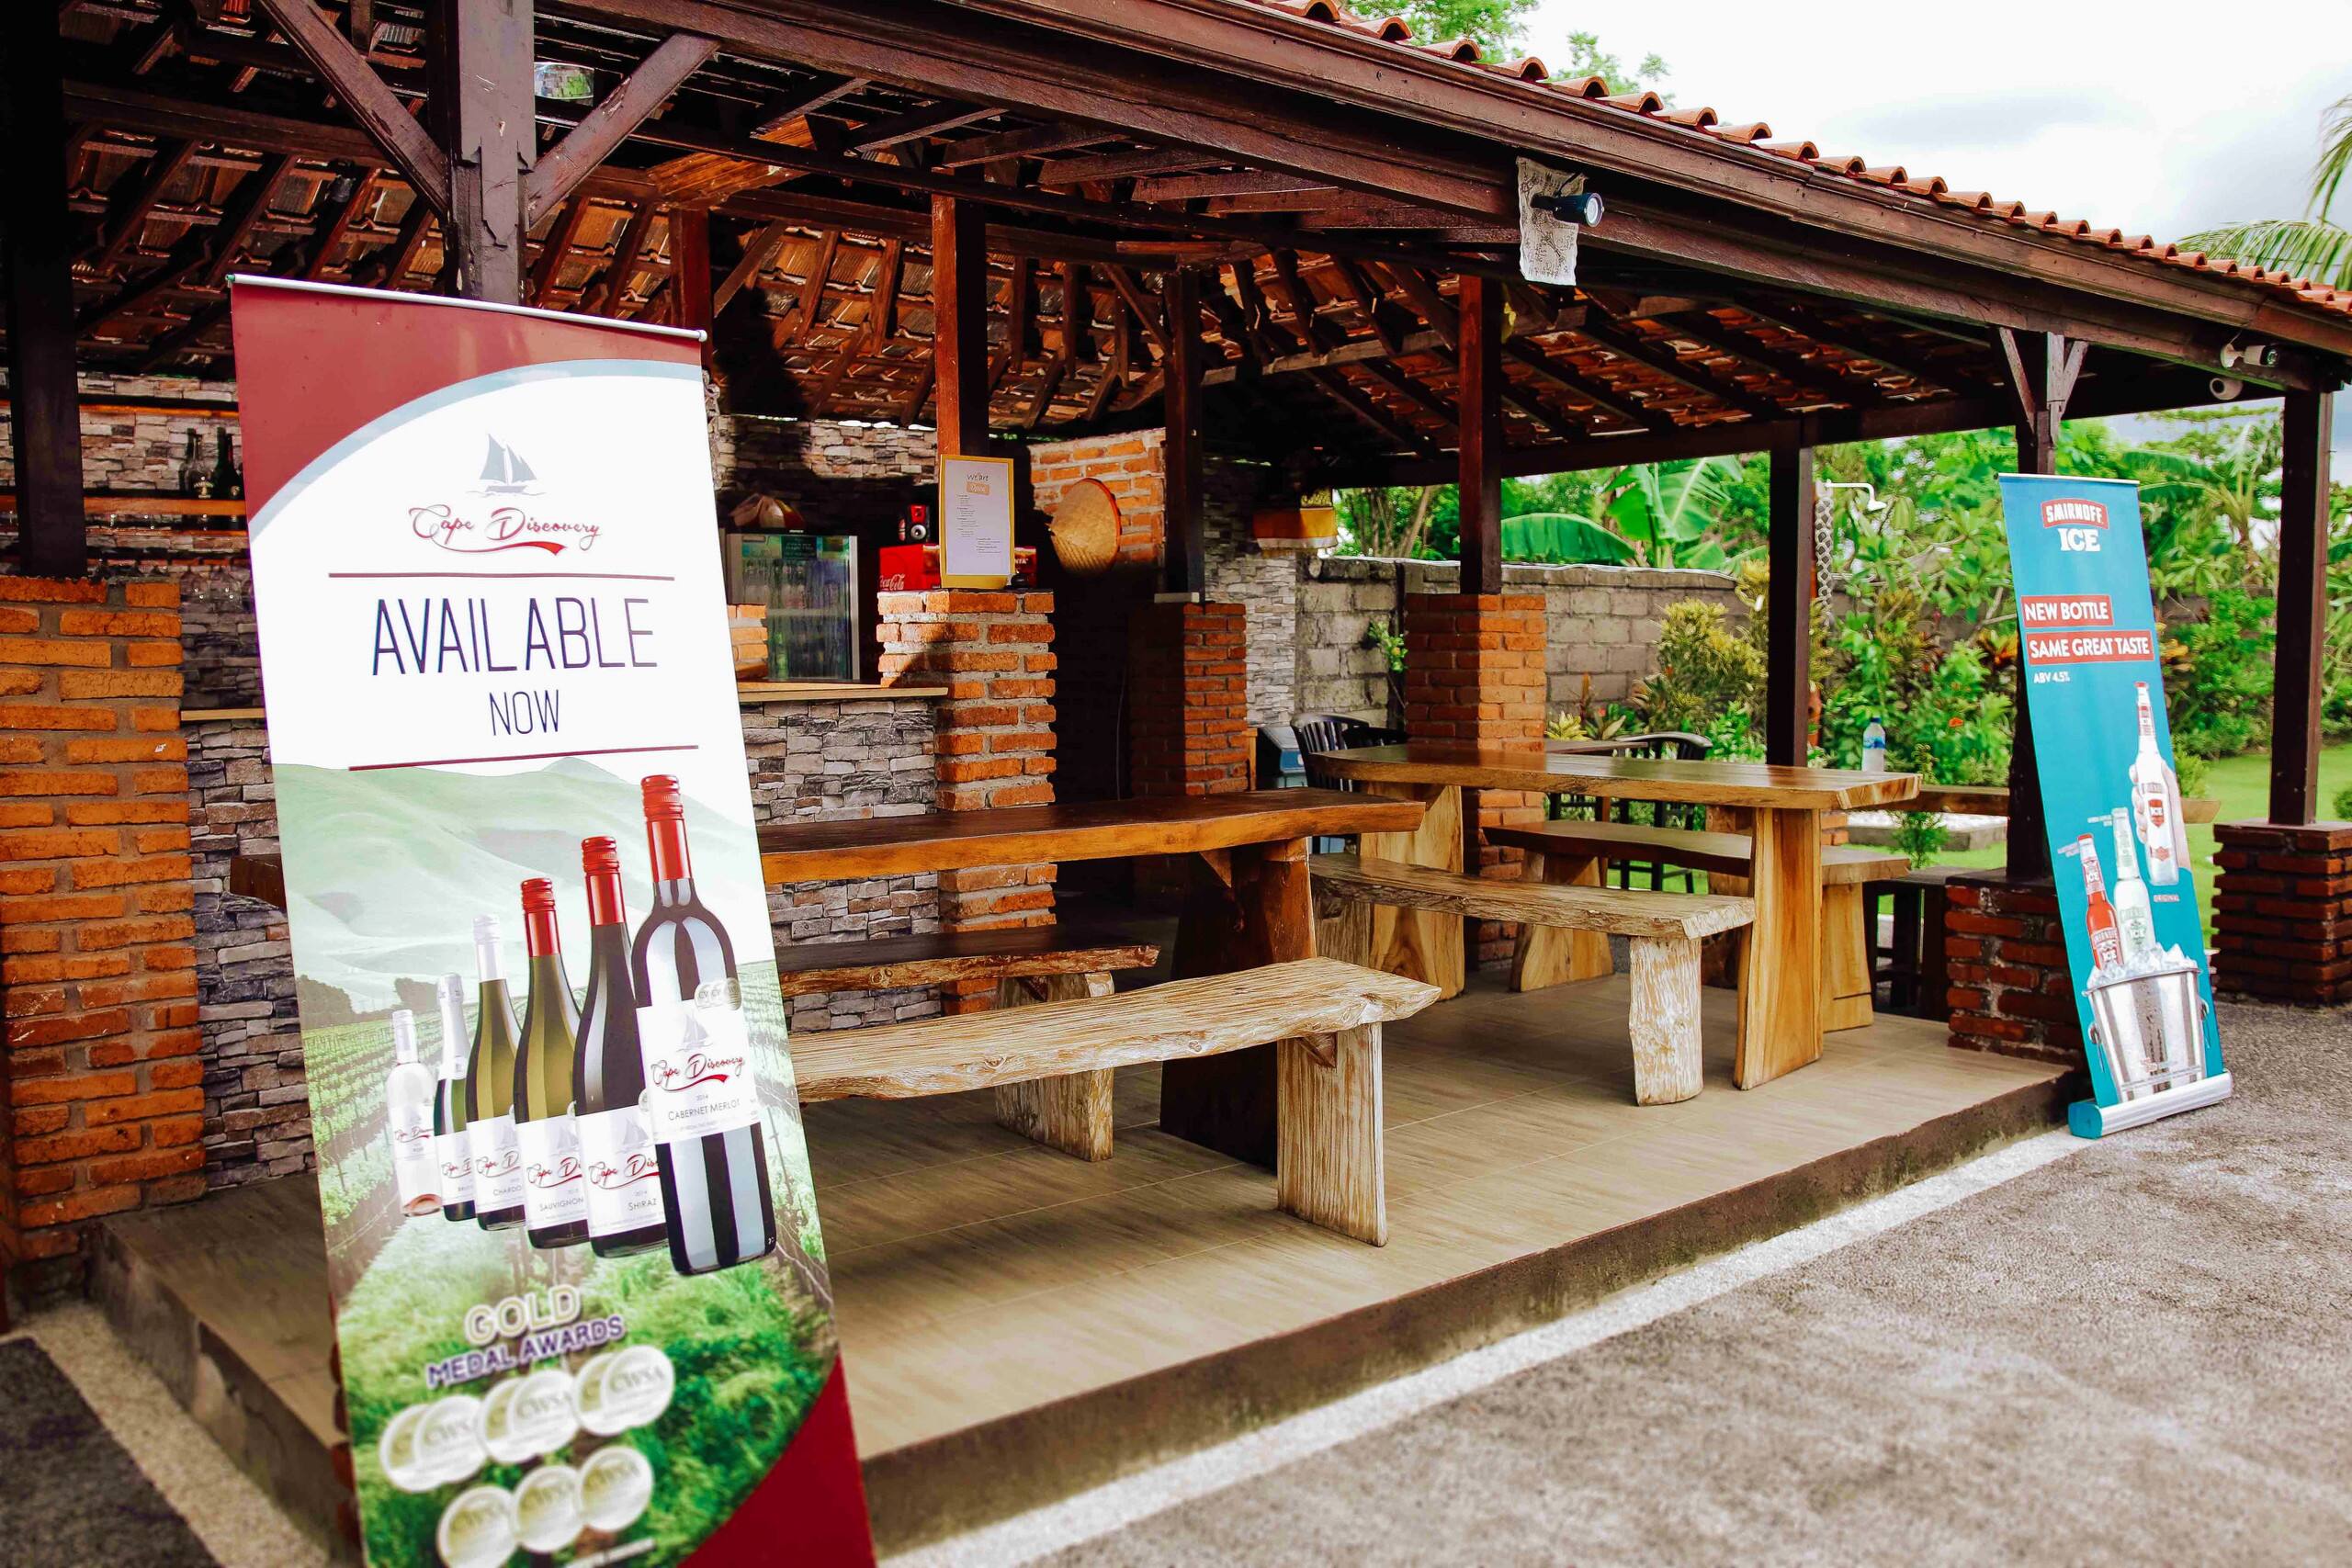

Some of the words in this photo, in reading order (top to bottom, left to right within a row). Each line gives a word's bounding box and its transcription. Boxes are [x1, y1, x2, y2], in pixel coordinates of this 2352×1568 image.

[2046, 502, 2103, 523] SMIRNOFF
[409, 504, 474, 545] Cape
[485, 507, 604, 551] Discovery
[2058, 528, 2100, 551] ICE
[2024, 603, 2058, 621] NEW
[2060, 602, 2109, 620] BOTTLE
[373, 597, 658, 675] AVAILABLE
[2029, 639, 2071, 659] SAME
[2072, 637, 2114, 656] GREAT
[2113, 637, 2151, 655] TASTE
[2033, 672, 2052, 683] ABV
[489, 689, 560, 736] NOW
[668, 1106, 708, 1122] CABERNET
[709, 1098, 741, 1113] MERLOT
[539, 1197, 584, 1212] SAUVIGNON
[628, 1198, 658, 1212] SHIRAZ
[466, 1286, 580, 1345] GOLD
[428, 1347, 515, 1387] MEDAL
[520, 1315, 625, 1361] AWARDS
